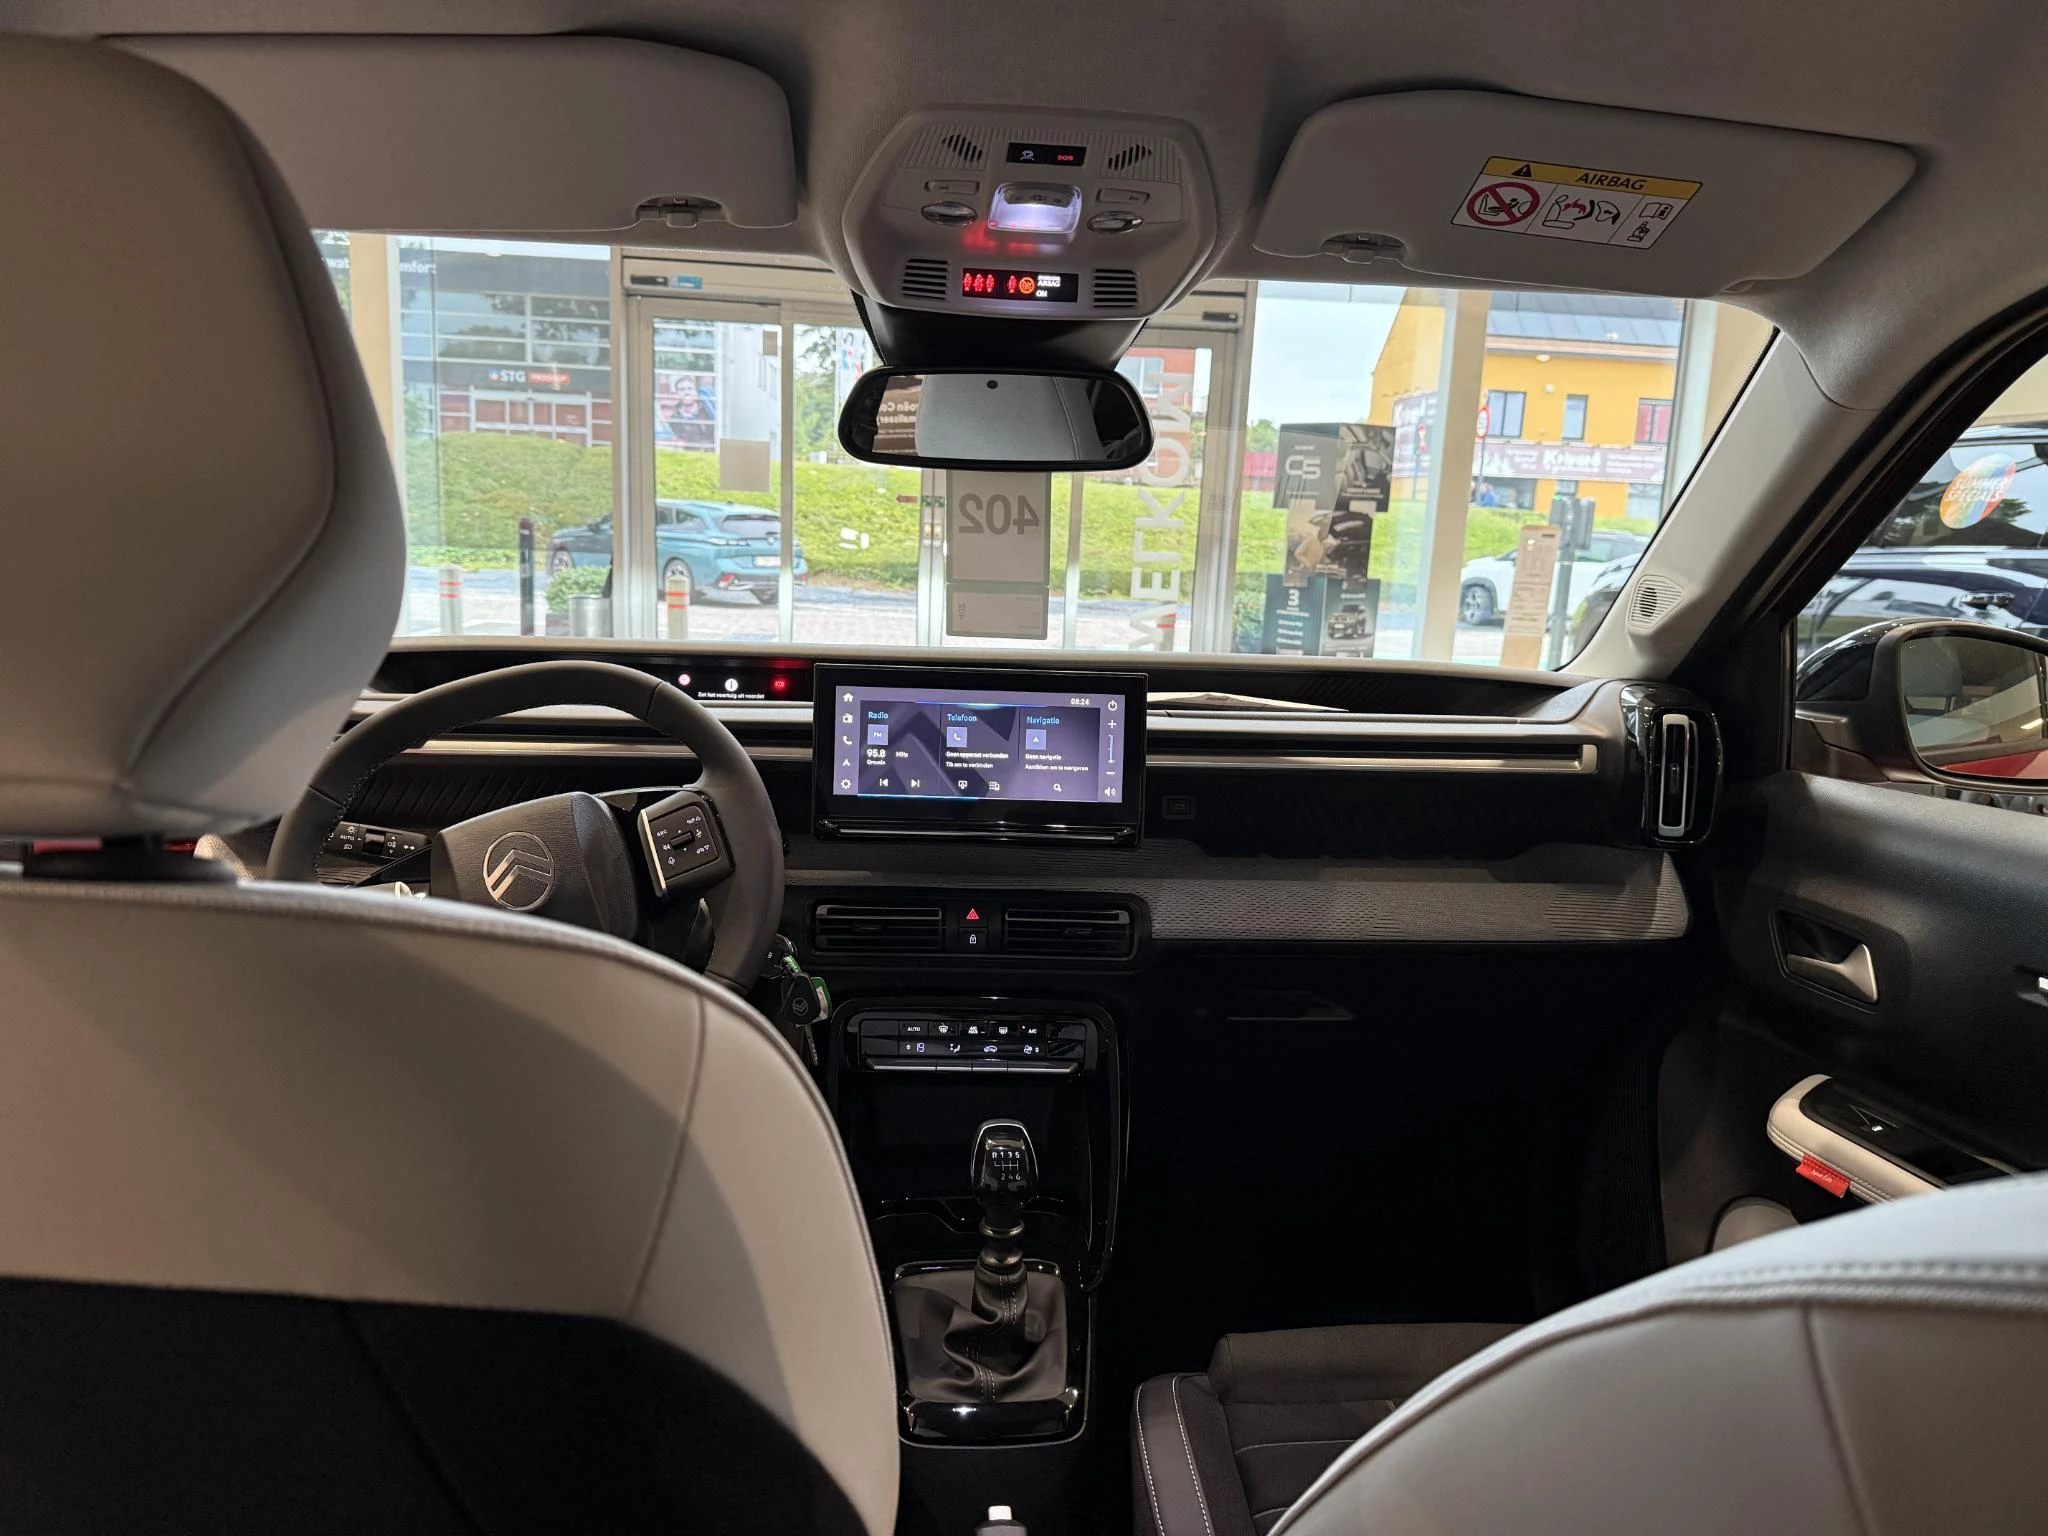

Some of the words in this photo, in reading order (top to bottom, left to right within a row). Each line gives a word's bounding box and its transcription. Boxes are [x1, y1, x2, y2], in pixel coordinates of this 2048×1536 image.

[1575, 172, 1647, 191] AIRBAG
[1288, 589, 1300, 606] 3
[868, 711, 889, 719] Radio
[946, 713, 977, 722] Telefoon
[1026, 716, 1060, 725] Navigatie
[866, 748, 886, 758] 95.8
